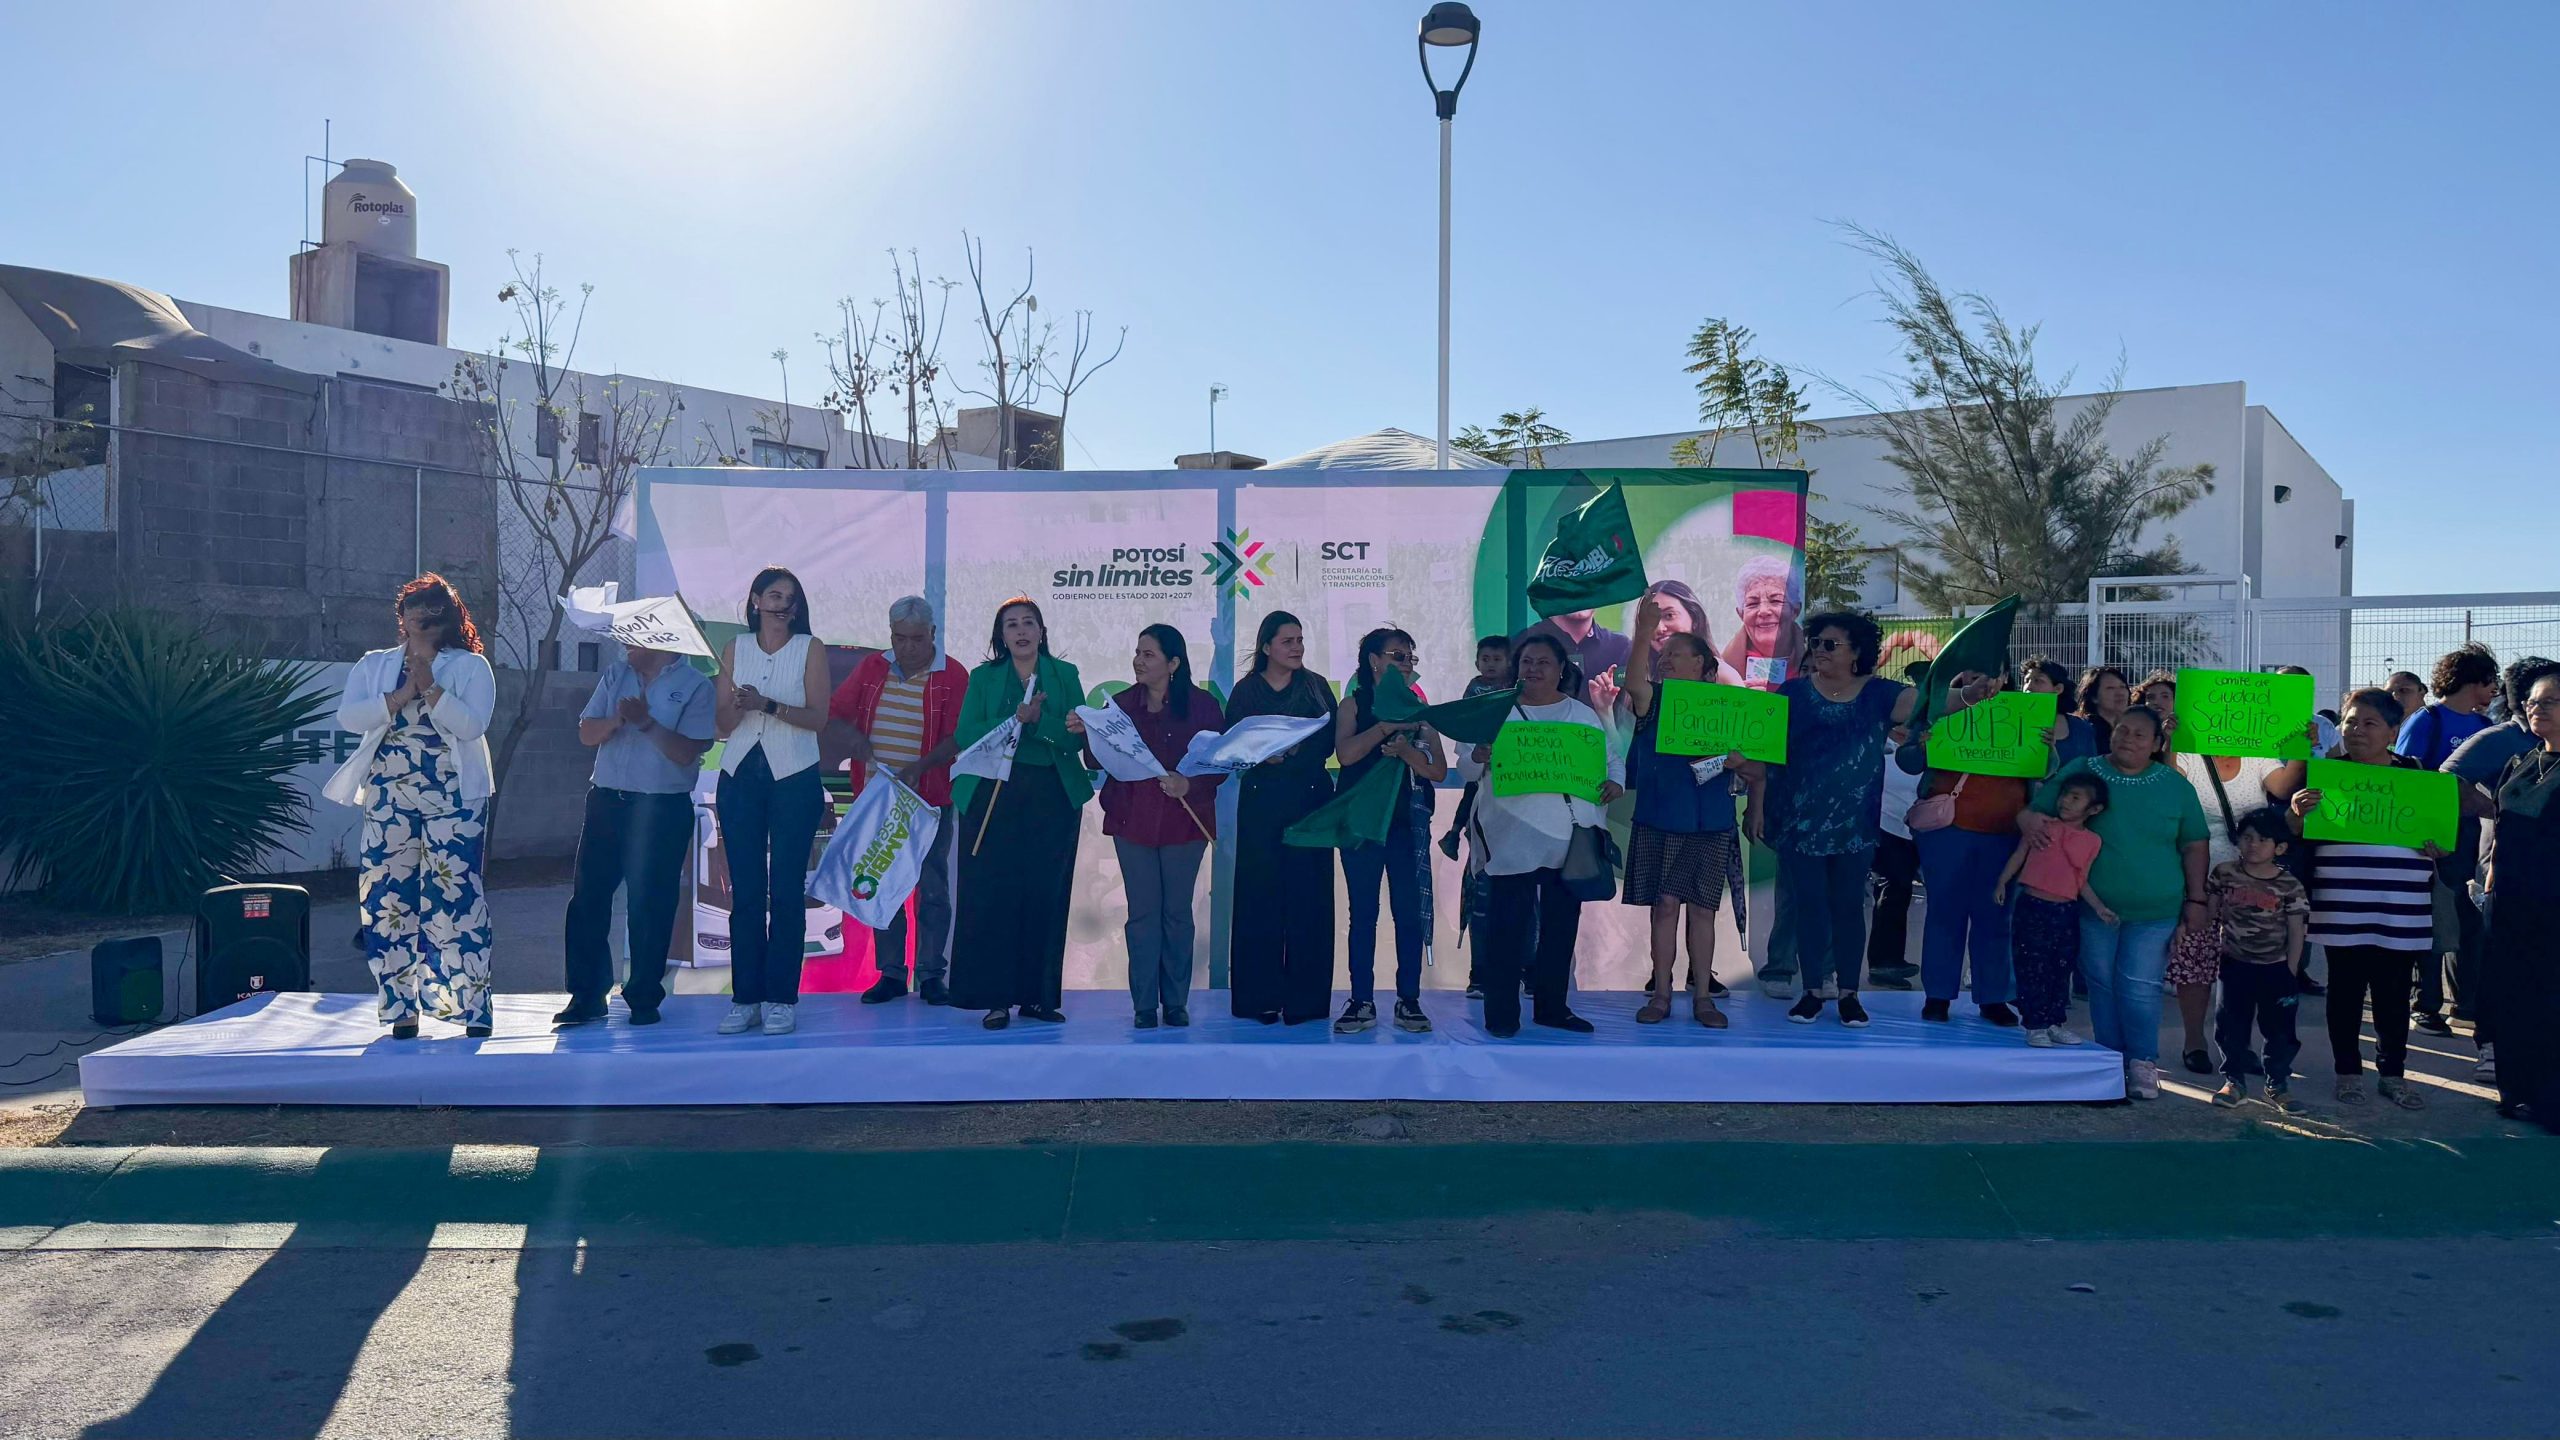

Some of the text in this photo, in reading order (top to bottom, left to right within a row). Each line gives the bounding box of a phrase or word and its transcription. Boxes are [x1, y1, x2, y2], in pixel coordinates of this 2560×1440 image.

[354, 202, 404, 215] Rotoplas
[1112, 542, 1186, 562] POTOSÍ
[1321, 541, 1370, 560] SCT
[1052, 563, 1193, 588] sin límites
[1321, 566, 1370, 574] SECRETARÍA
[1116, 592, 1149, 600] ESTADO
[2255, 679, 2270, 688] de
[1672, 699, 1766, 739] Panalillo
[2191, 703, 2280, 738] Satelite
